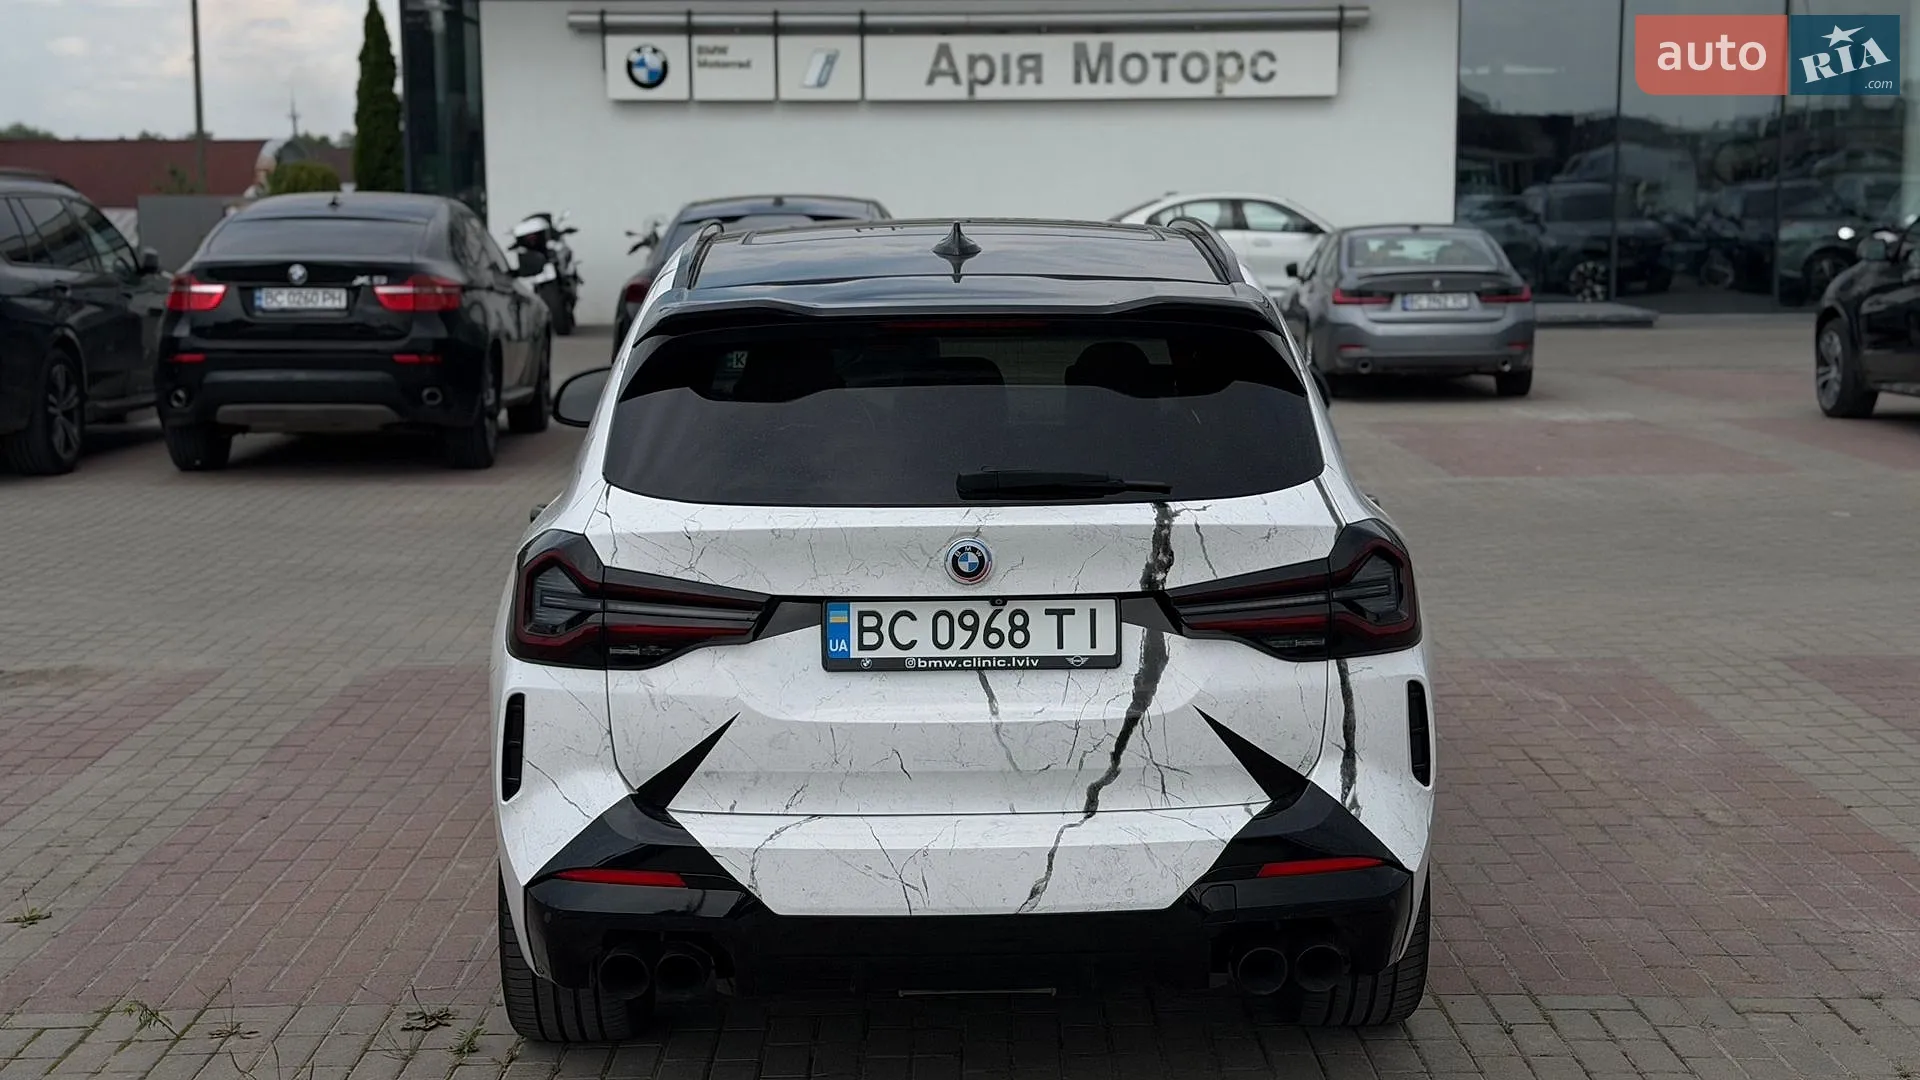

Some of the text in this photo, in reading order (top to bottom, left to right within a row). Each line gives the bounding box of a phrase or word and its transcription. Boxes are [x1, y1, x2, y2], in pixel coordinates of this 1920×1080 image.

[925, 41, 1277, 98] Арія Моторс
[857, 608, 1097, 651] BC 0968 TI
[829, 639, 848, 652] UA
[917, 657, 1039, 668] bmw.clinic.lviv
